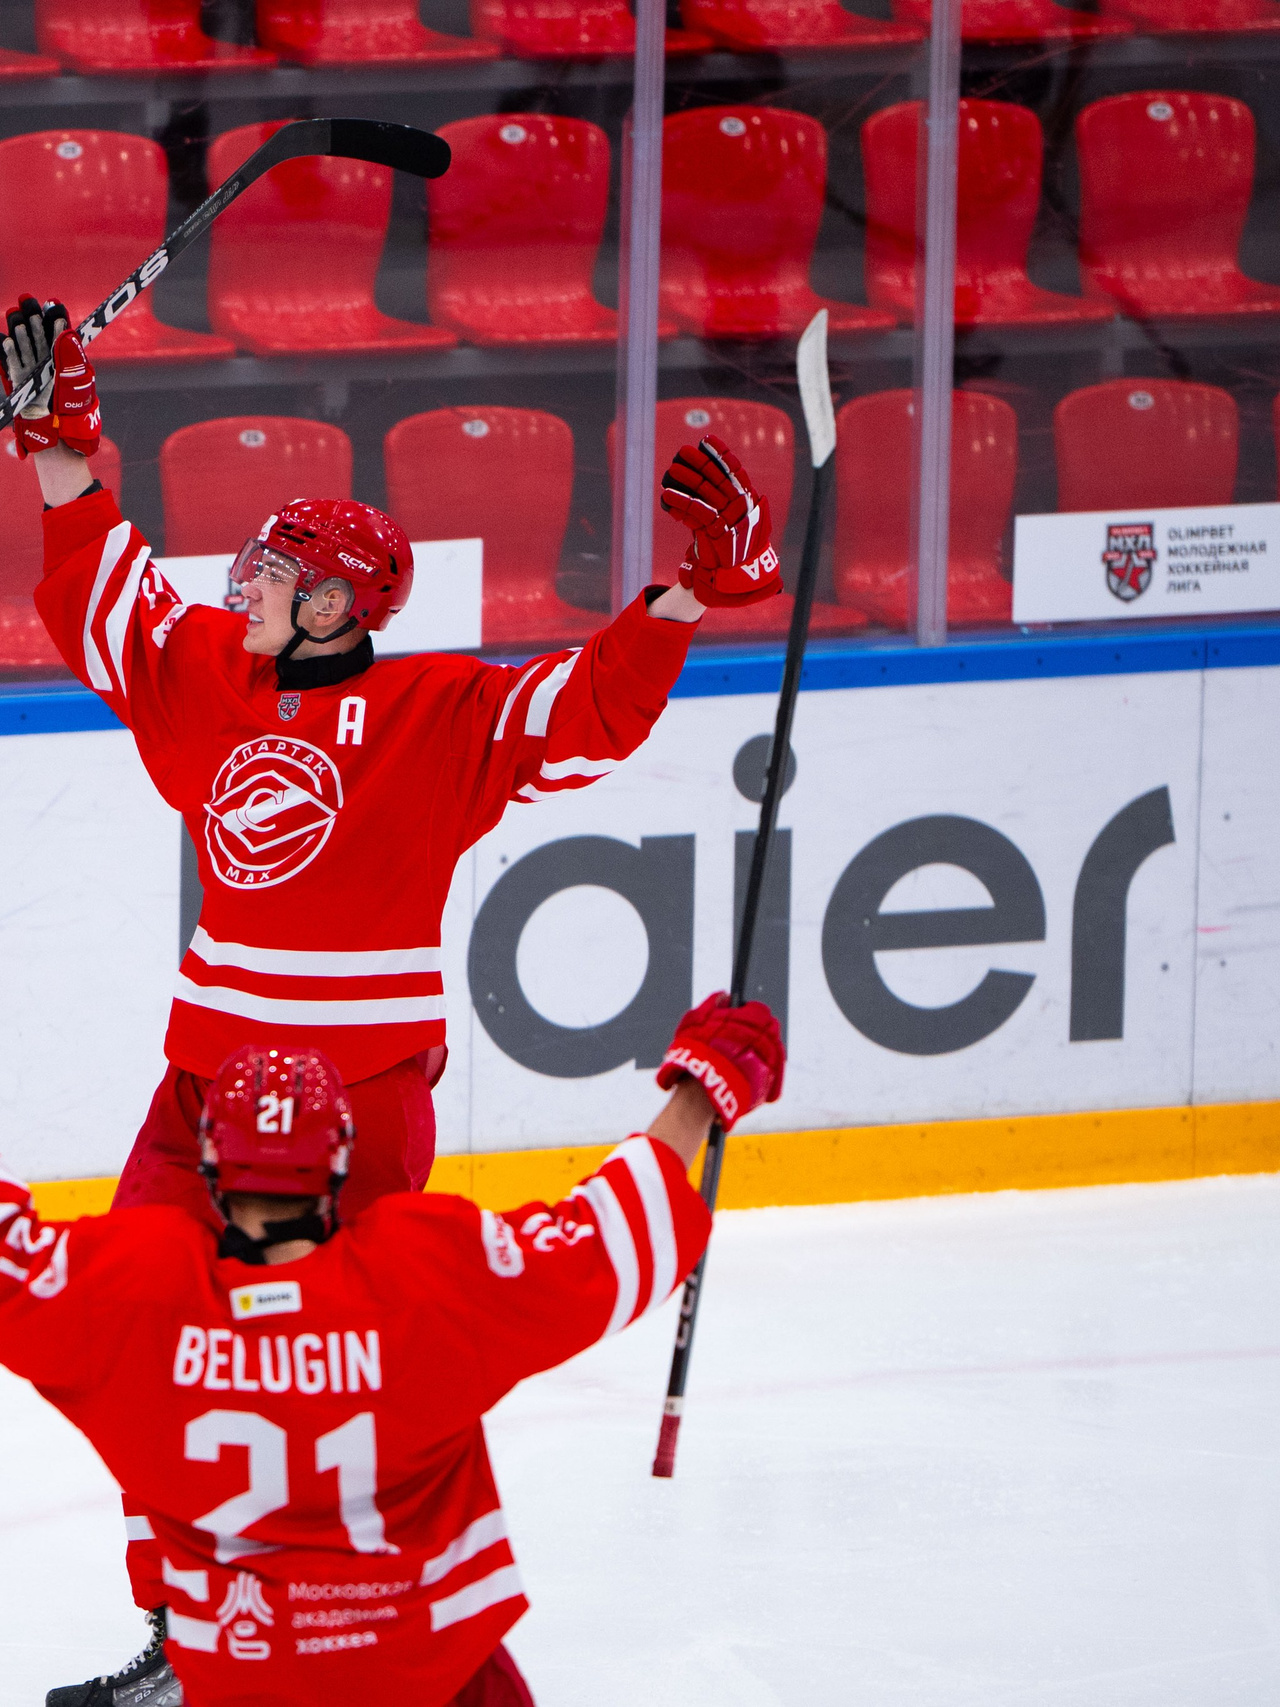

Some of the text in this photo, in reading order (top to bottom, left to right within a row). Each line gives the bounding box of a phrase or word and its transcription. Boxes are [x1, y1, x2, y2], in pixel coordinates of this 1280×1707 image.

[1168, 524, 1234, 541] OLIMPBET
[1168, 541, 1267, 560] МОЛОДЕЖНАЯ
[337, 551, 375, 574] CCM
[1168, 559, 1249, 575] ХОККЕЙНАЯ
[1167, 579, 1202, 593] ЛИГА
[230, 741, 328, 777] СПАРТАК
[226, 866, 270, 884] МАХ
[257, 1095, 294, 1134] 21
[173, 1324, 382, 1394] BELUGIN
[184, 1409, 401, 1564] 21
